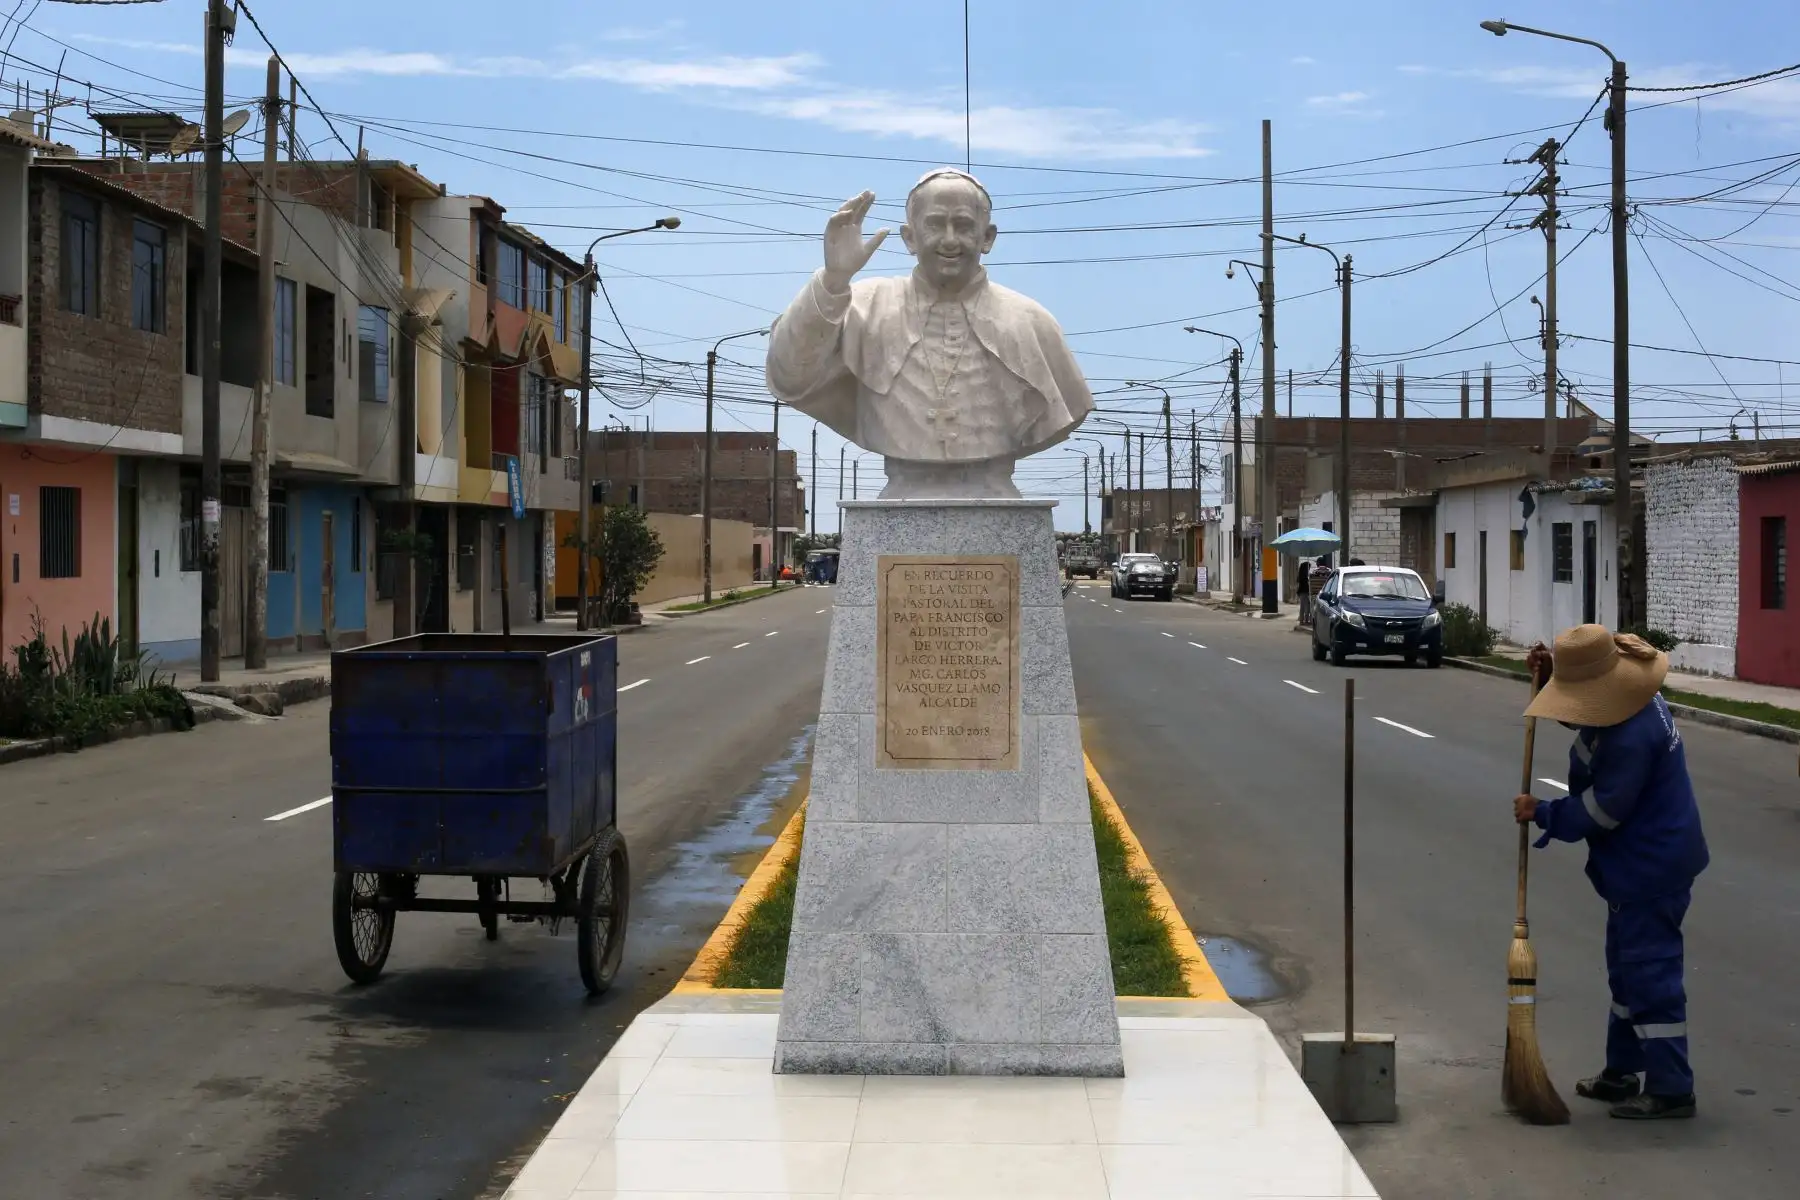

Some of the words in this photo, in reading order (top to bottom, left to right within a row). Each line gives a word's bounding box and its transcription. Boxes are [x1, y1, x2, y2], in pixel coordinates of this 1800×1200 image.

[904, 570, 920, 580] EN
[924, 570, 994, 580] RECUERDO
[929, 584, 944, 594] LA
[947, 584, 989, 594] VISITA
[903, 599, 967, 608] PASTORAL
[970, 599, 995, 608] DEL
[894, 612, 924, 622] PAPA
[928, 612, 1004, 623] FRANCISCO
[909, 626, 924, 637] AL
[928, 626, 988, 637] DISTRITO
[914, 640, 931, 651] DE
[935, 640, 984, 651] VICTOR
[894, 655, 937, 665] LARCO
[909, 669, 934, 679] MG.
[936, 669, 987, 679] CARLOS
[896, 683, 954, 695] VASQUEZ
[956, 683, 1002, 694] LLAMO
[919, 698, 978, 708] ALCALDE
[905, 728, 919, 736] 20
[921, 725, 964, 736] ENERO
[966, 727, 990, 736] 2018
